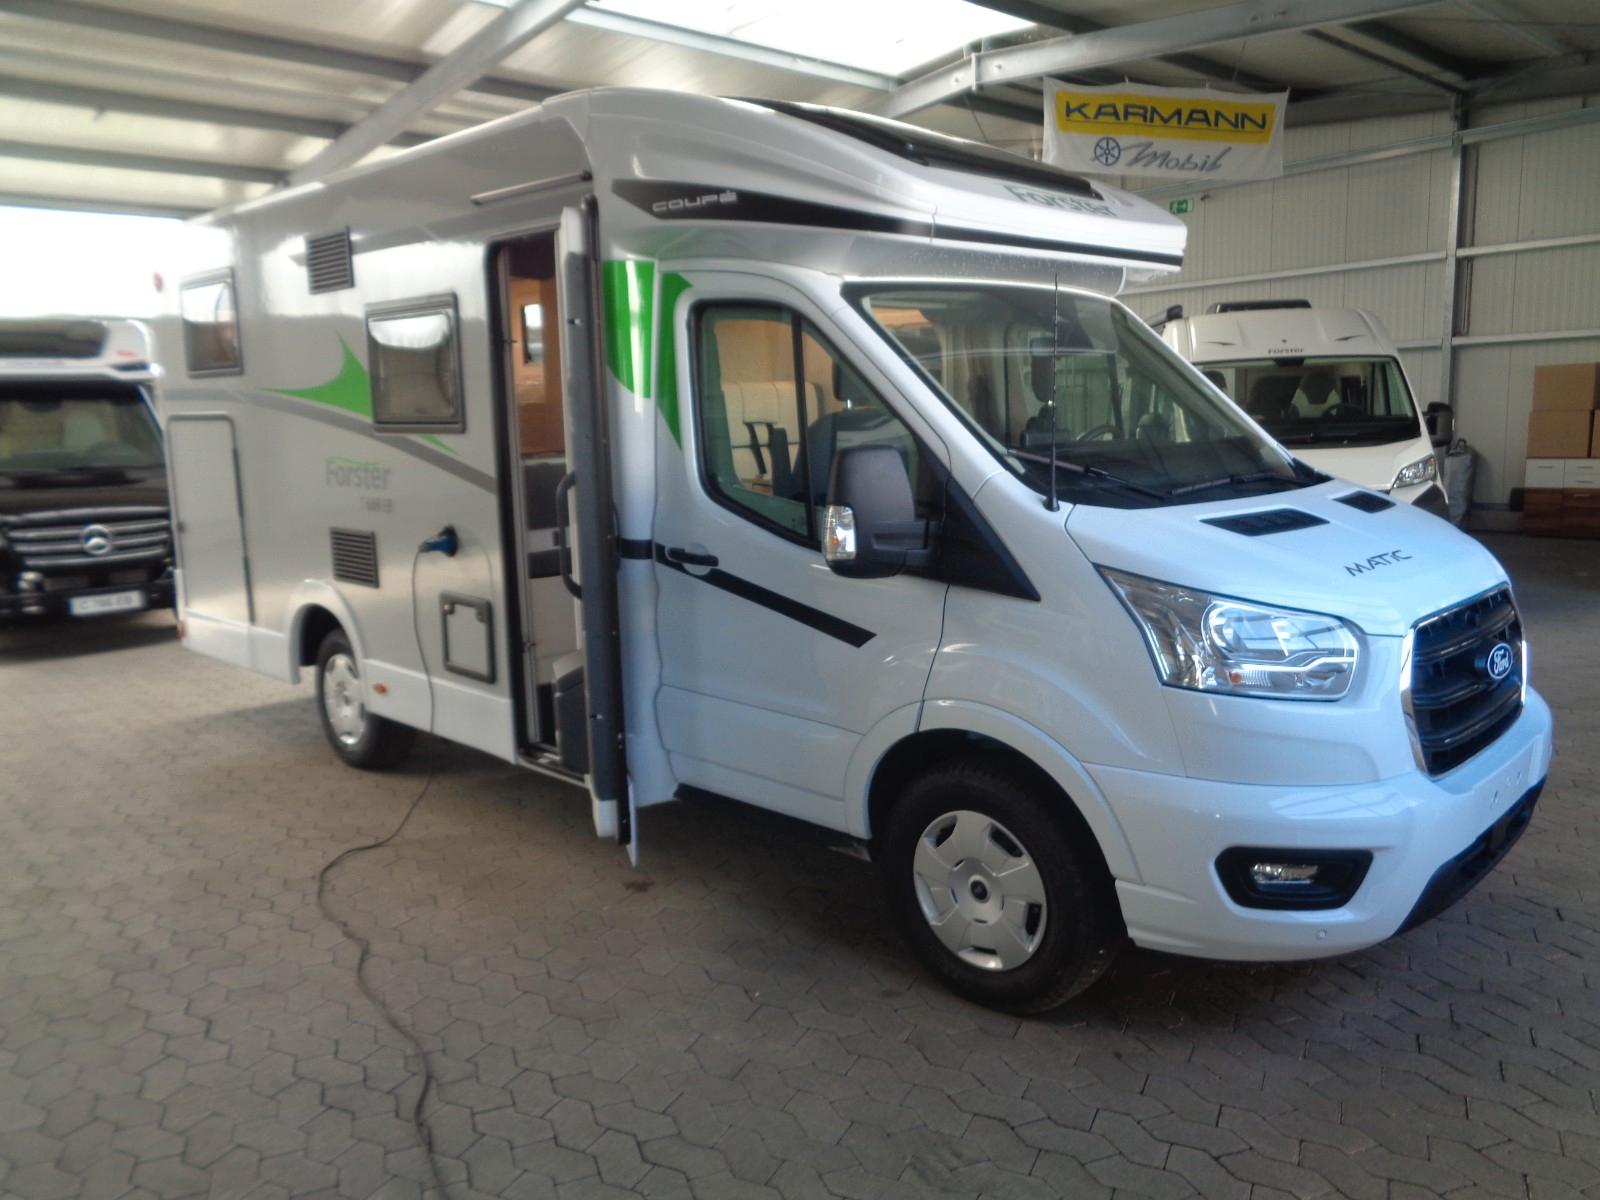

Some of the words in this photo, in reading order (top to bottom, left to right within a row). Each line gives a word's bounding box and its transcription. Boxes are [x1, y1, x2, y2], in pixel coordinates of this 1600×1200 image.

[1065, 101, 1266, 130] KARMANN
[1120, 141, 1232, 172] Mobil
[1343, 549, 1413, 577] MATIC
[1492, 647, 1510, 676] Ford
